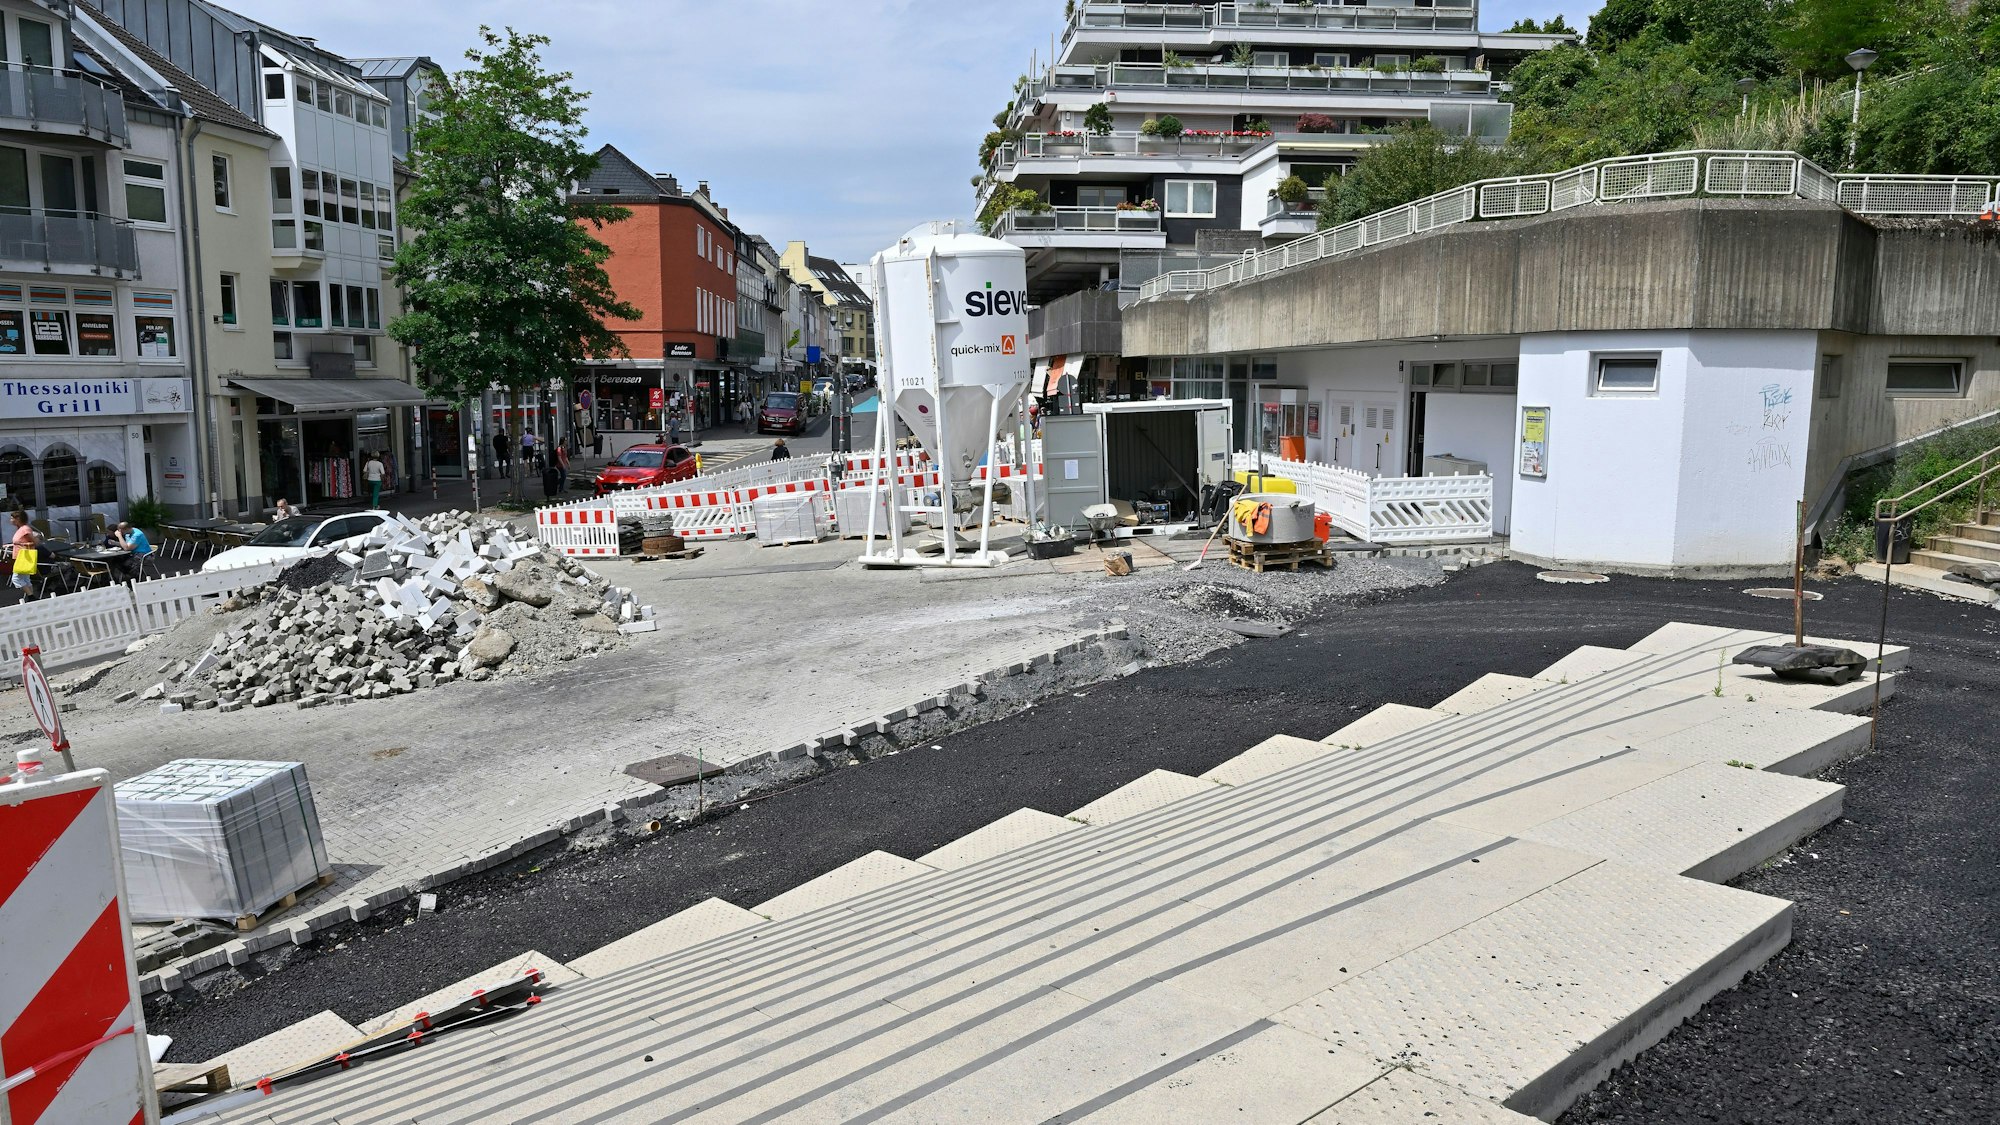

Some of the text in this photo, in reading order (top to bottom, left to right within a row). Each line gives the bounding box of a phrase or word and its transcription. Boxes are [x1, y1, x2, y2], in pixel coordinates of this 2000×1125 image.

[33, 321, 62, 334] 123
[950, 343, 1001, 357] quick-mix
[573, 374, 641, 384] Leder Berensen
[901, 376, 925, 387] 11021
[4, 381, 129, 395] Thessaloniki
[37, 399, 101, 413] Grill
